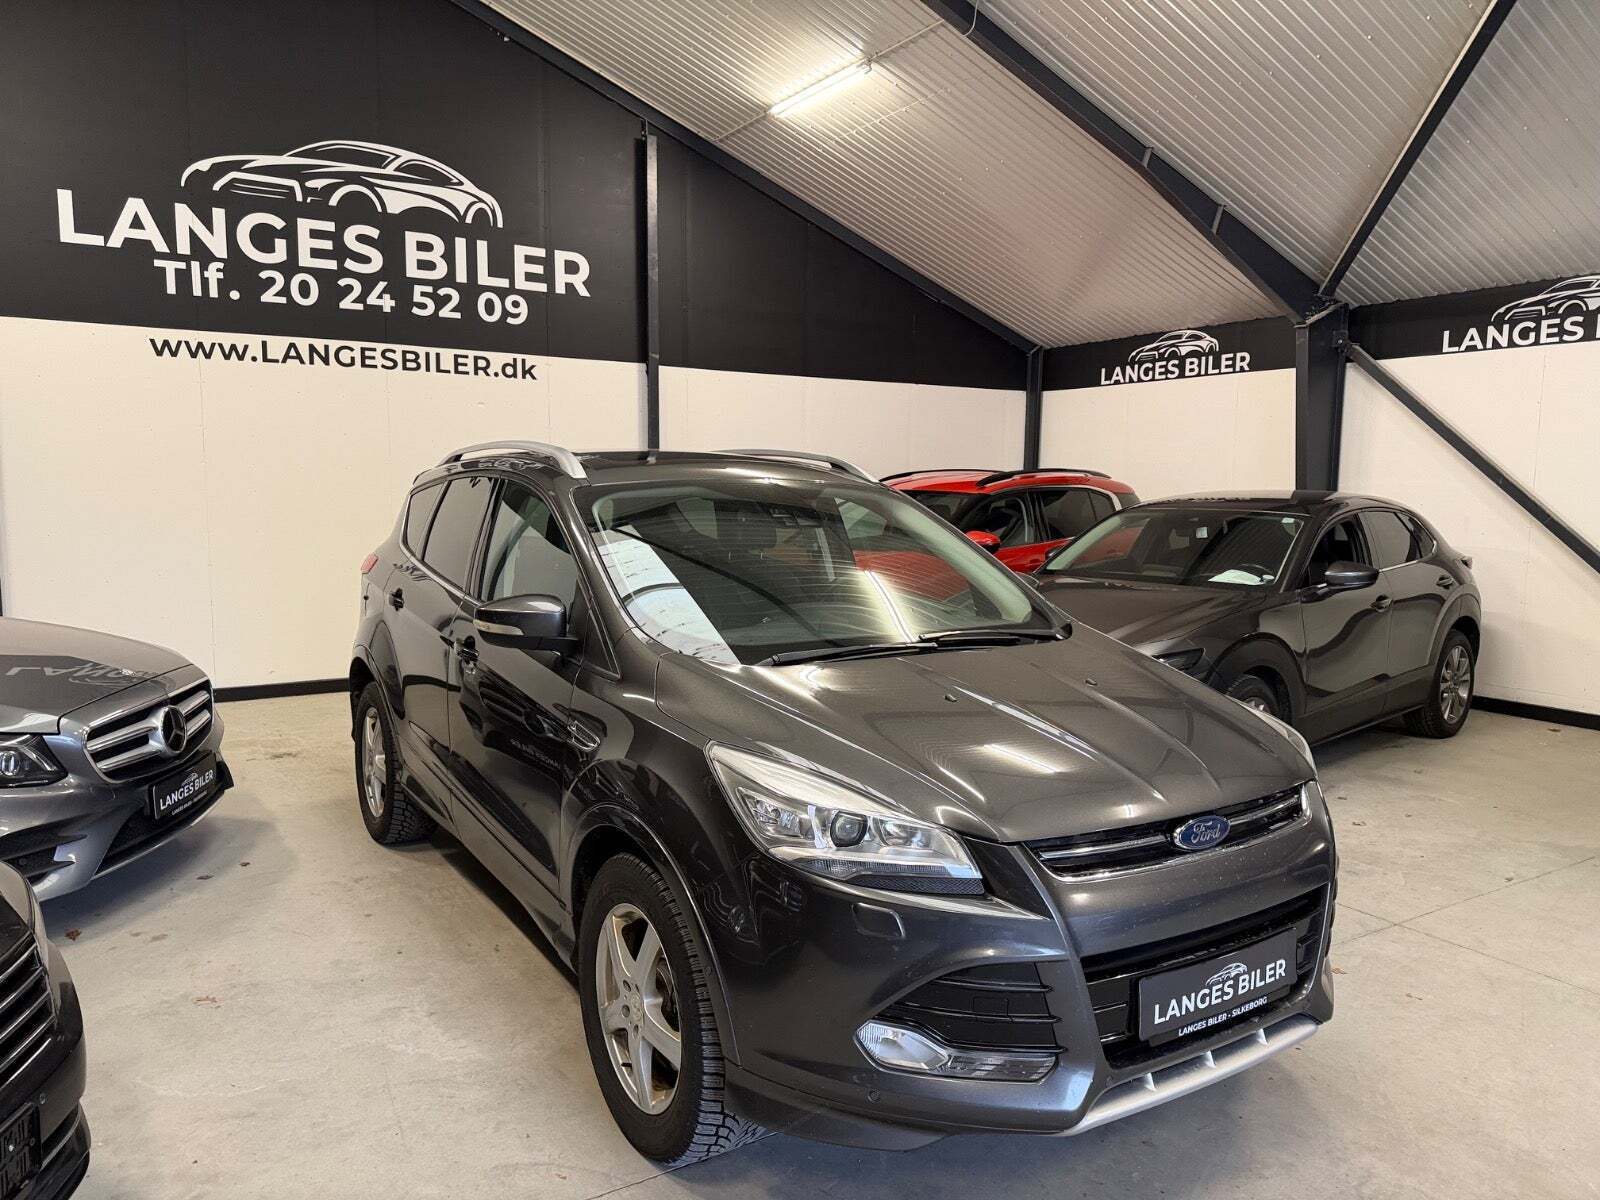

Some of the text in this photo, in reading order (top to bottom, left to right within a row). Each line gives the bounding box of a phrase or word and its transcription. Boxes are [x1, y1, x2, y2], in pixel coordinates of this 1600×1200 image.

[56, 188, 591, 298] LANGES BILER
[153, 258, 529, 325] Tlf. 20 24 52 09
[1441, 315, 1585, 353] LANGES
[148, 337, 538, 381] www.LANGESBILER.dk
[1100, 351, 1251, 386] LANGES BILER
[160, 783, 194, 810] LANGES
[194, 770, 214, 790] BILER
[1190, 820, 1221, 844] Ford
[1154, 959, 1286, 1025] LANGES BILER
[1178, 996, 1268, 1036] LANGES BILER SILKEBORG
